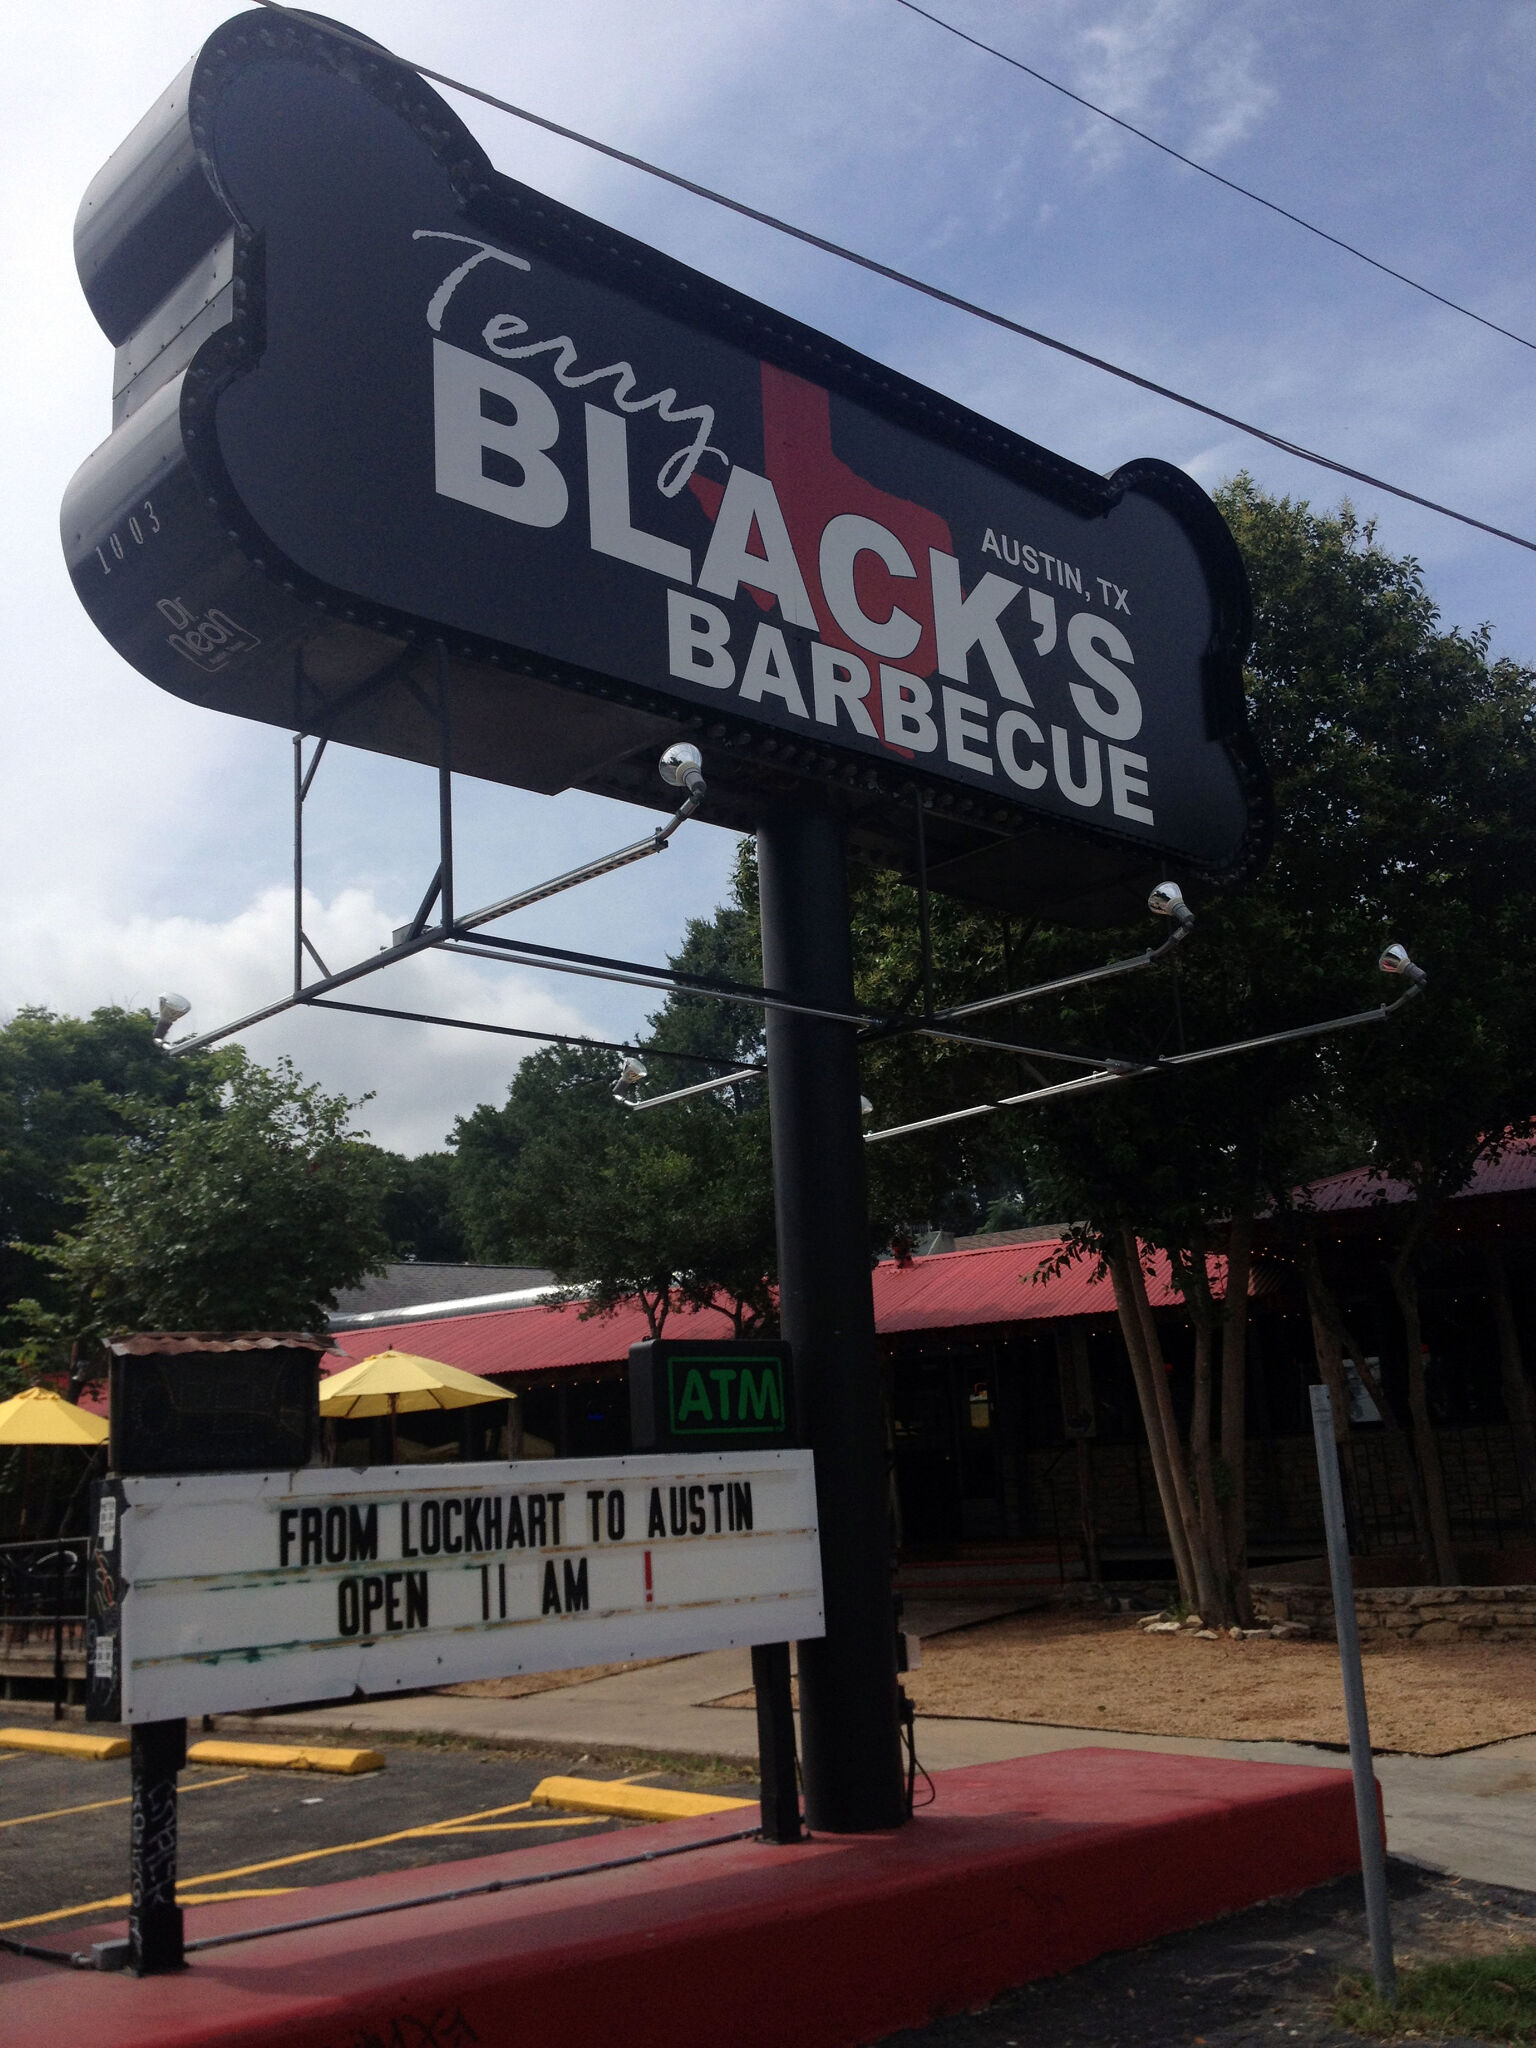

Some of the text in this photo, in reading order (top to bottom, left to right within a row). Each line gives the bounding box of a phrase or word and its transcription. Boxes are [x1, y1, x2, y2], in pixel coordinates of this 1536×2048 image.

[413, 229, 729, 498] Terry
[95, 500, 160, 575] 1003
[433, 337, 1143, 741] BLACK'S
[980, 527, 1132, 615] AUSTIN, TX
[666, 588, 1155, 826] BARBECUE
[677, 1367, 781, 1422] ATM
[279, 1482, 753, 1567] FROM LOCKHART TO AUSTIN
[337, 1570, 429, 1636] OPEN
[542, 1557, 589, 1616] AM
